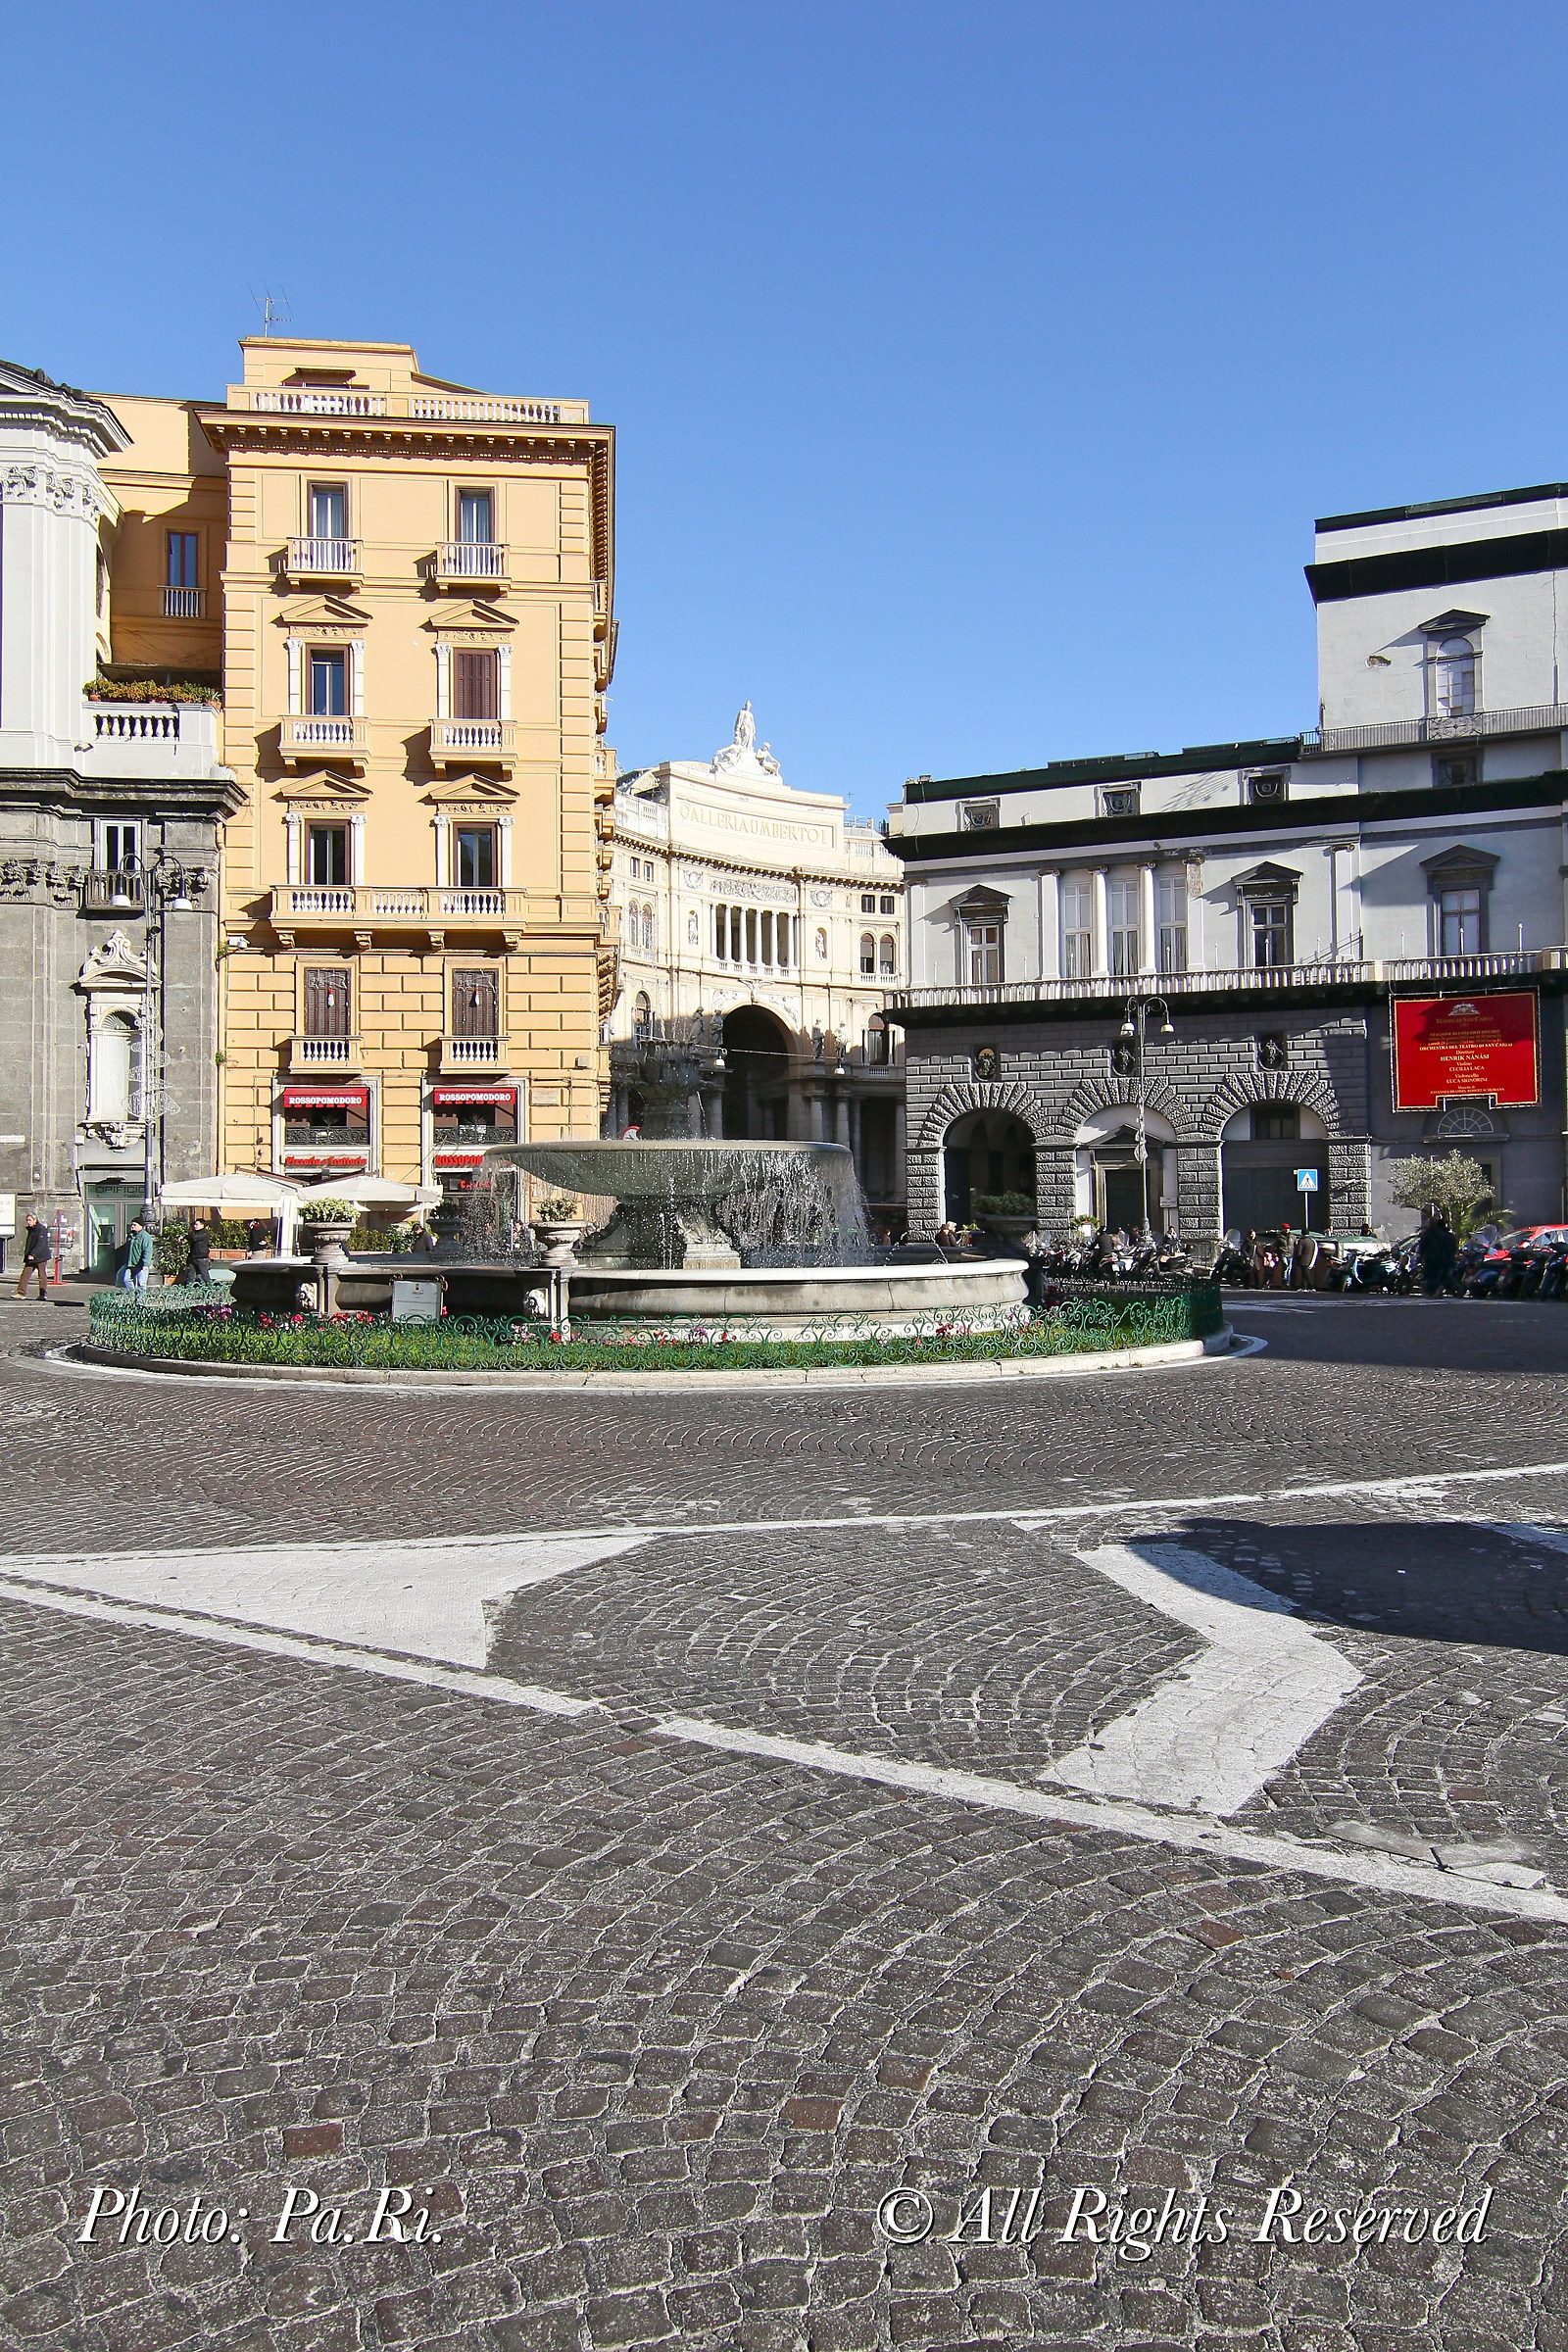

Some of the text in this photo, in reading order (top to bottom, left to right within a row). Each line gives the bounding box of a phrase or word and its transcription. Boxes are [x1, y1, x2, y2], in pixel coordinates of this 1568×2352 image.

[679, 803, 749, 835] GALLERIA
[750, 819, 819, 844] UMBERTO
[438, 1093, 512, 1102] ROSSOPOMODORO
[284, 1156, 320, 1166] Pizzeria
[327, 1155, 368, 1166] Trattoria
[435, 1154, 485, 1166] ROSSOPOM
